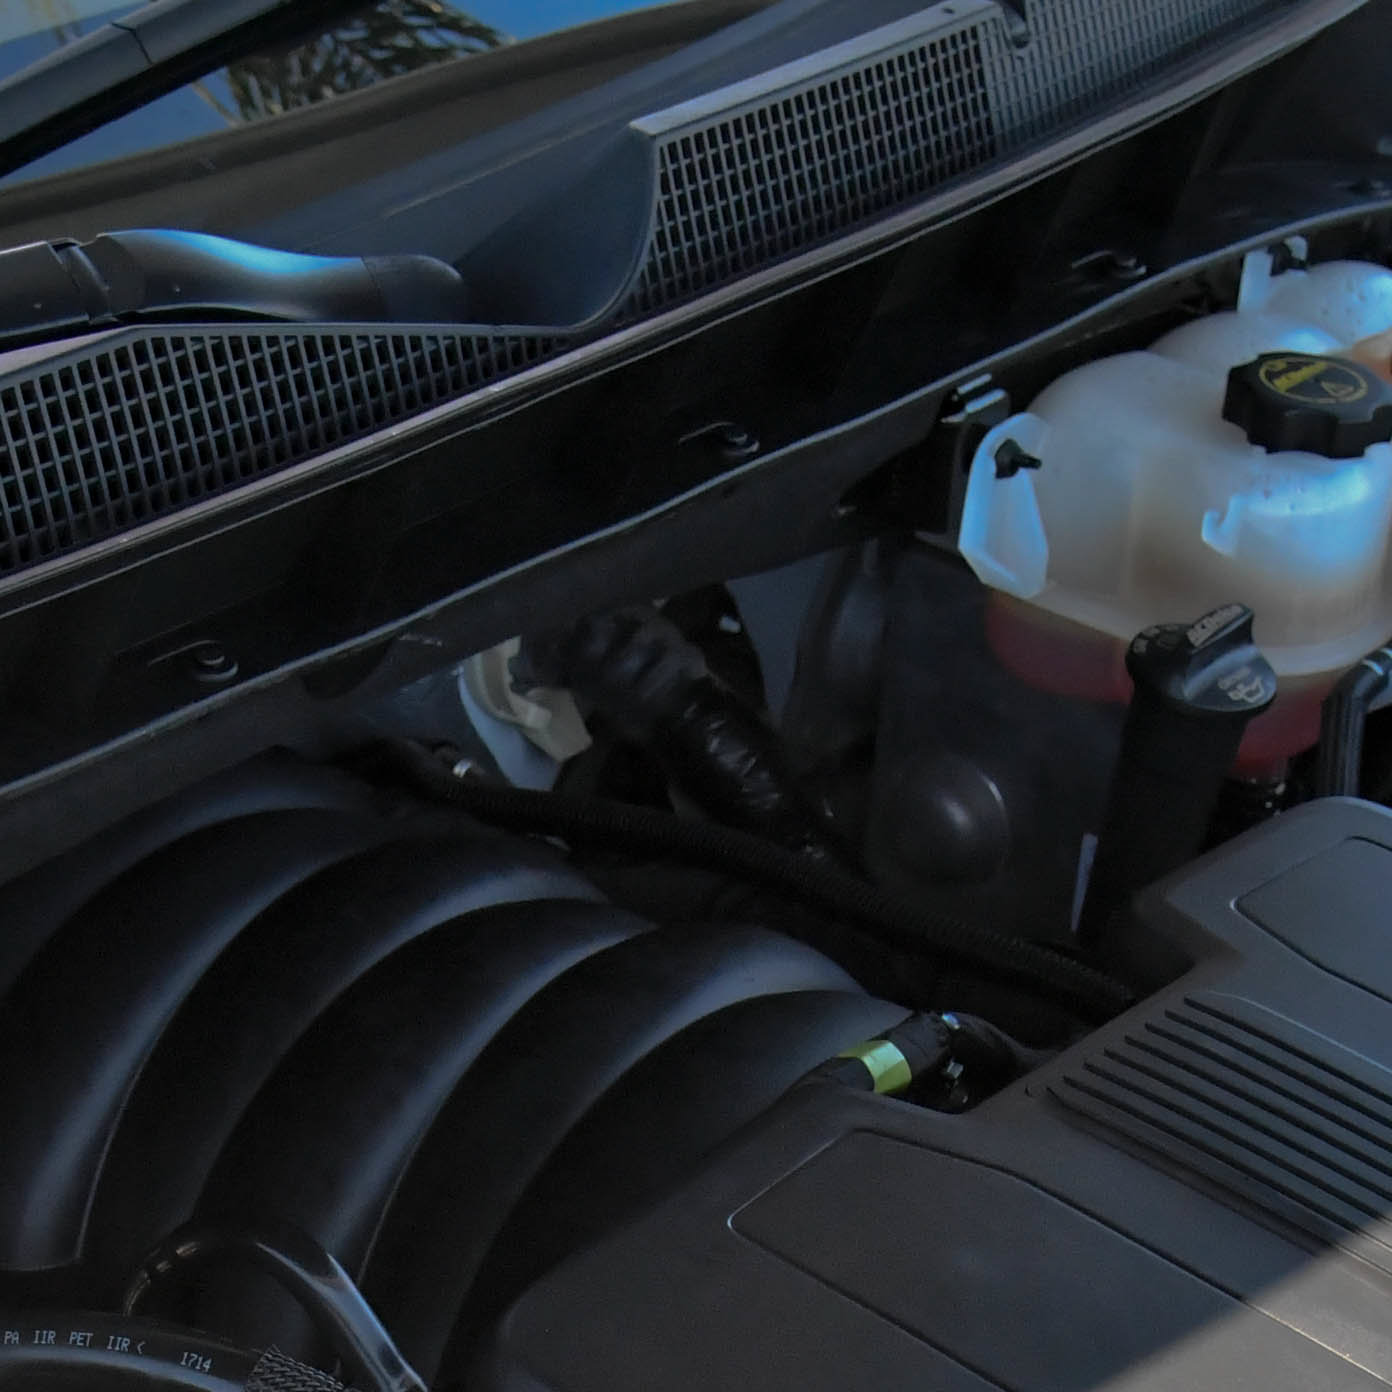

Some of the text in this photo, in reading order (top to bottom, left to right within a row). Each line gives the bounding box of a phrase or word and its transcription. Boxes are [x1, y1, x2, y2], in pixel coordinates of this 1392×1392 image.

[4, 1330, 20, 1345] PA
[68, 1331, 93, 1347] PET
[179, 1352, 213, 1373] 1714
